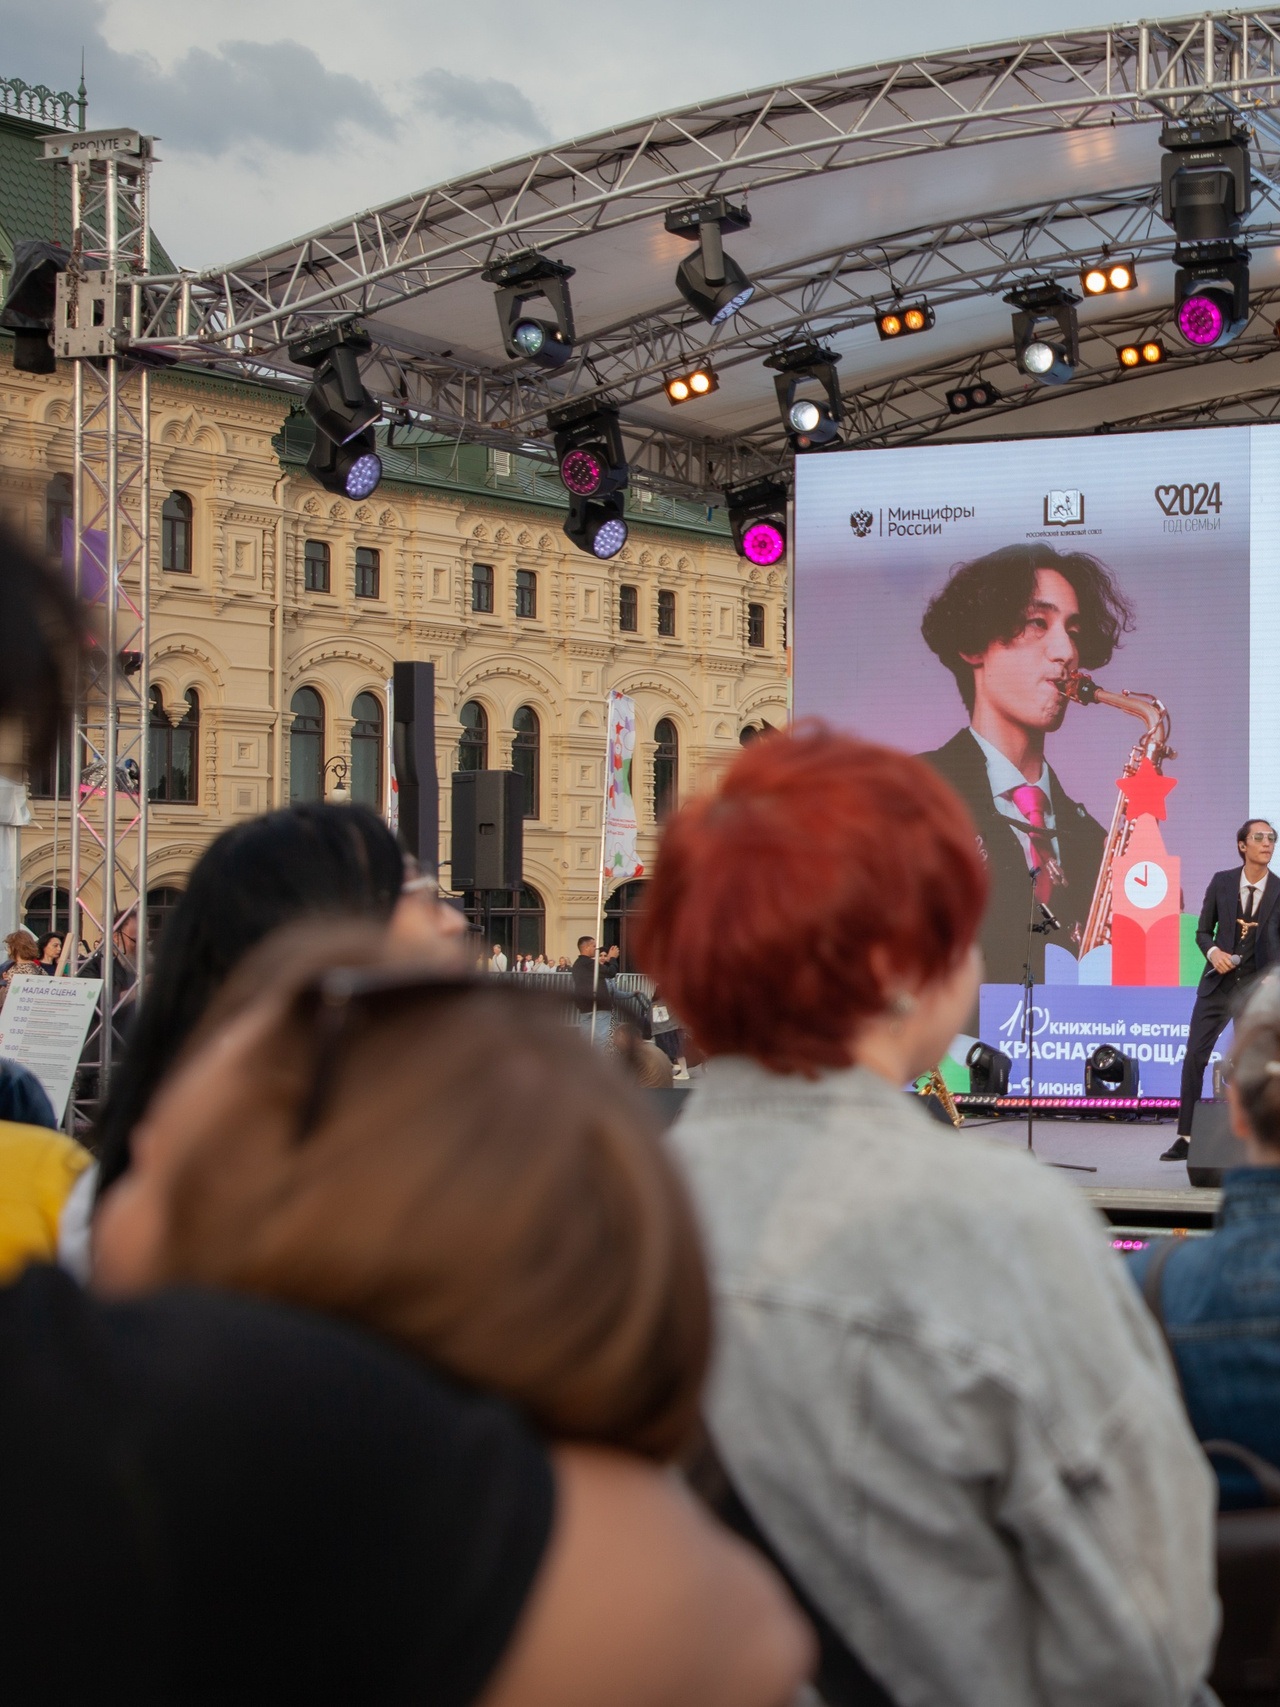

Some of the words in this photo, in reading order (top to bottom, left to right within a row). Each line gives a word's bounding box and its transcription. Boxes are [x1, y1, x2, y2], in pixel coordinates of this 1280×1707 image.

[1154, 482, 1223, 516] 2024
[888, 505, 975, 522] Минцифры
[888, 522, 942, 537] России
[22, 986, 50, 996] МАЛАЯ
[50, 988, 77, 997] СЦЕНА
[1050, 1020, 1126, 1036] КНИЖНЫЙ
[999, 1041, 1099, 1060] КРАСНАЯ
